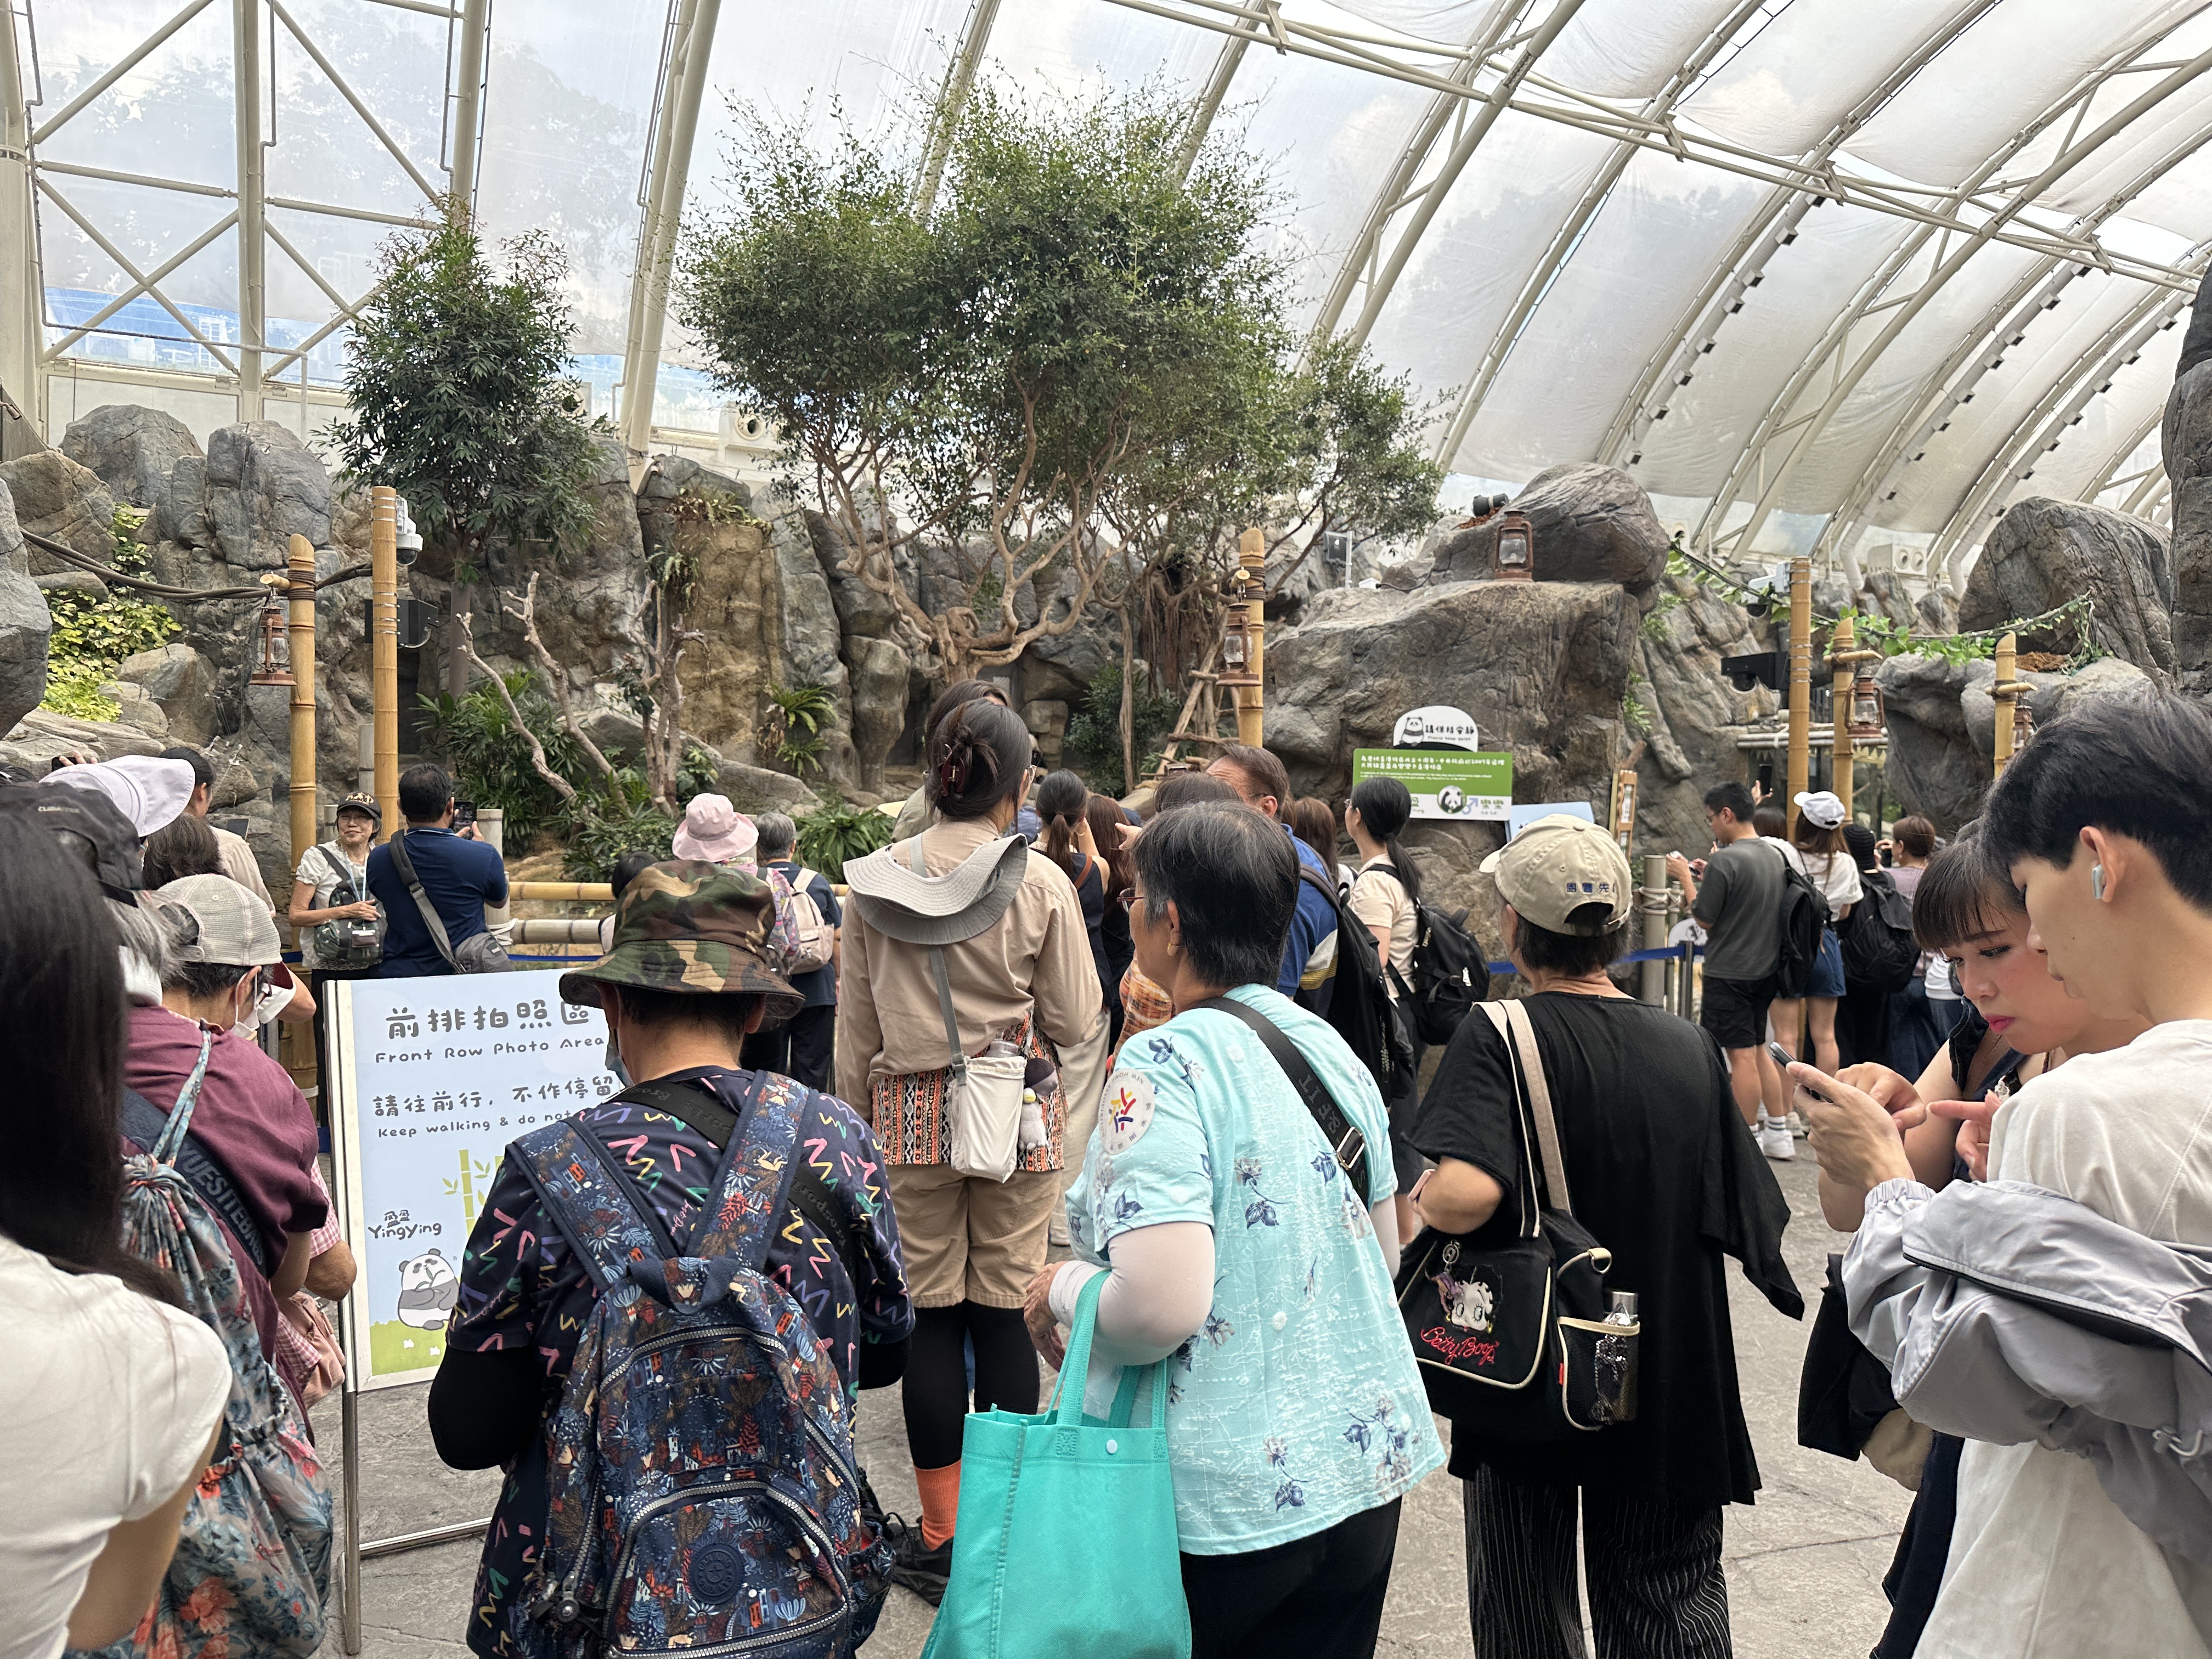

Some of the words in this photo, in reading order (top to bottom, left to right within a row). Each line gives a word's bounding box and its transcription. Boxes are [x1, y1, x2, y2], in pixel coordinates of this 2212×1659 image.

[386, 998, 589, 1039] 前排拍照區
[375, 1048, 433, 1064] Front
[444, 1045, 483, 1059] Row
[494, 1040, 550, 1056] Photo
[560, 1035, 605, 1048] Area
[1130, 1073, 1144, 1085] NEW
[378, 1126, 417, 1139] Keep
[426, 1118, 491, 1135] walking
[500, 1115, 509, 1126] &
[518, 1113, 536, 1125] do
[544, 1109, 572, 1123] not
[383, 1209, 411, 1227] 盈盈
[1420, 1326, 1459, 1365] Betty
[1456, 1336, 1500, 1366] Boop
